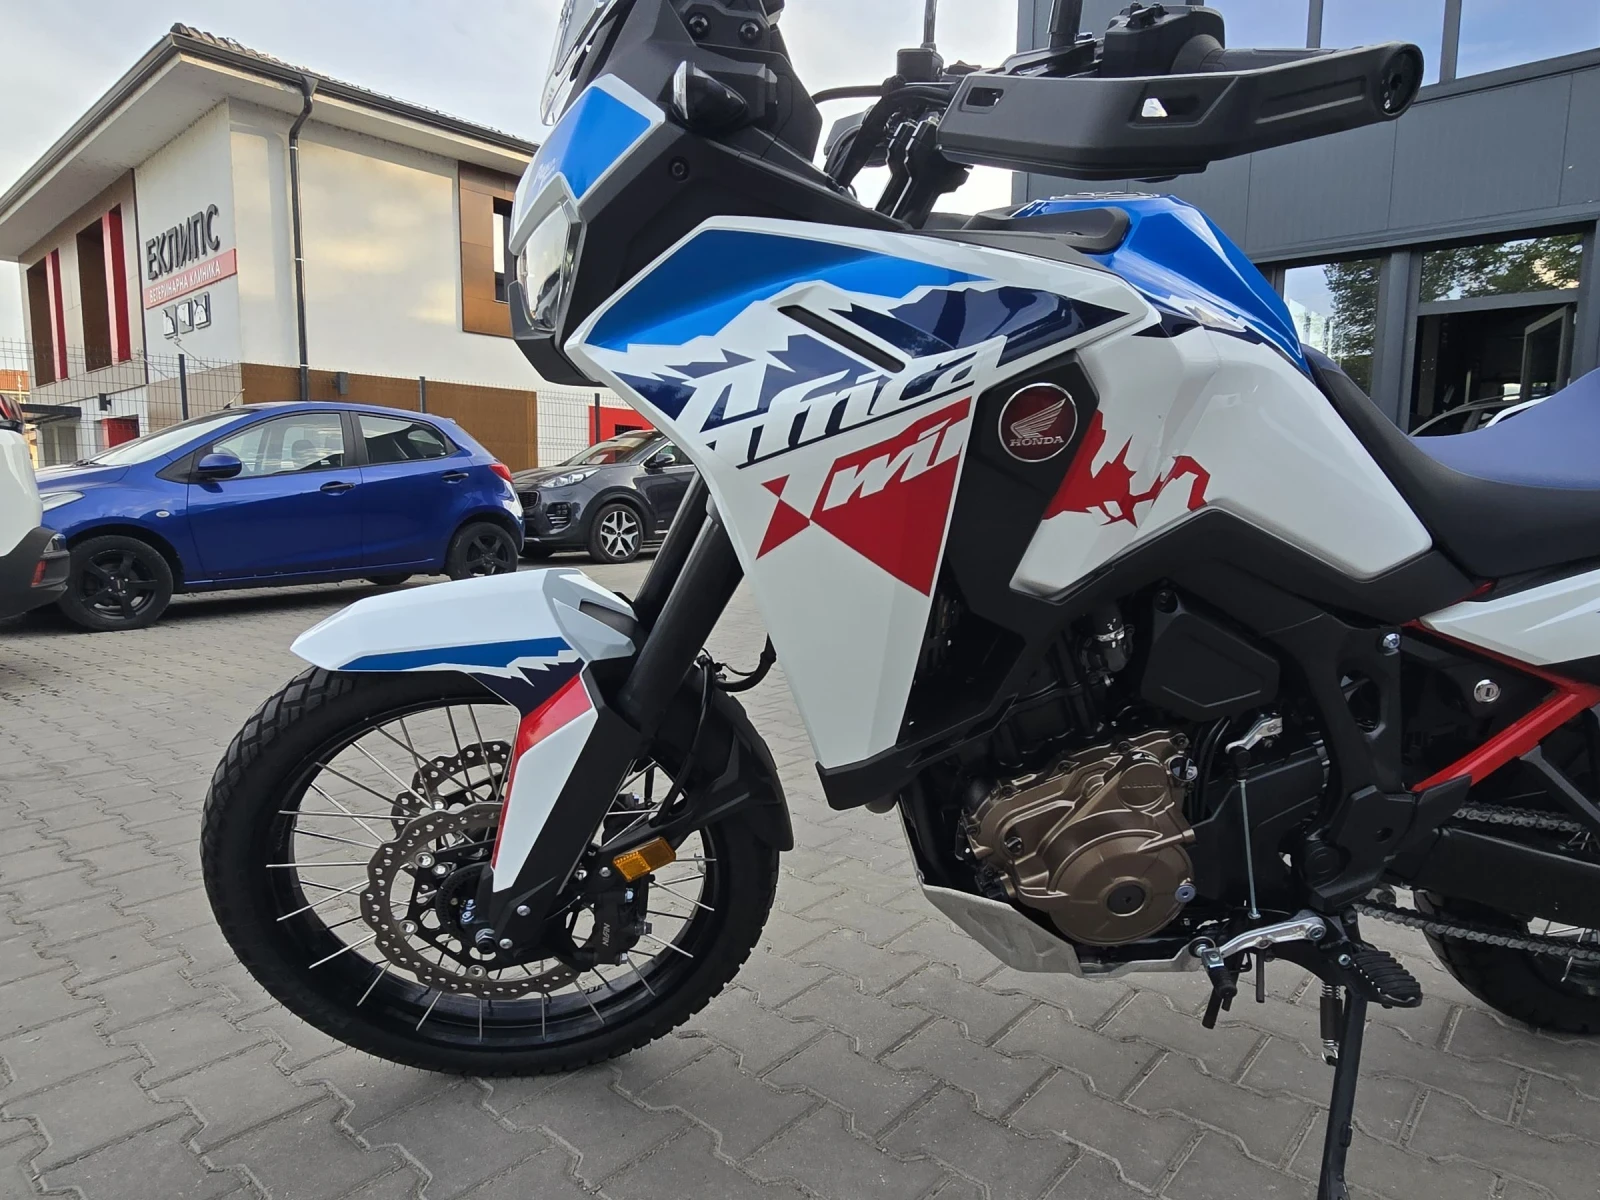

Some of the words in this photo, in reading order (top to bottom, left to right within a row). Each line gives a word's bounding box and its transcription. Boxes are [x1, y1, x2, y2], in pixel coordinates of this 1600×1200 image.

[146, 204, 220, 280] ЕКЛИПС
[149, 275, 189, 303] ВЕТЕРИНАРНА
[190, 261, 221, 285] КЛИНИКА
[1009, 435, 1065, 447] HONDA
